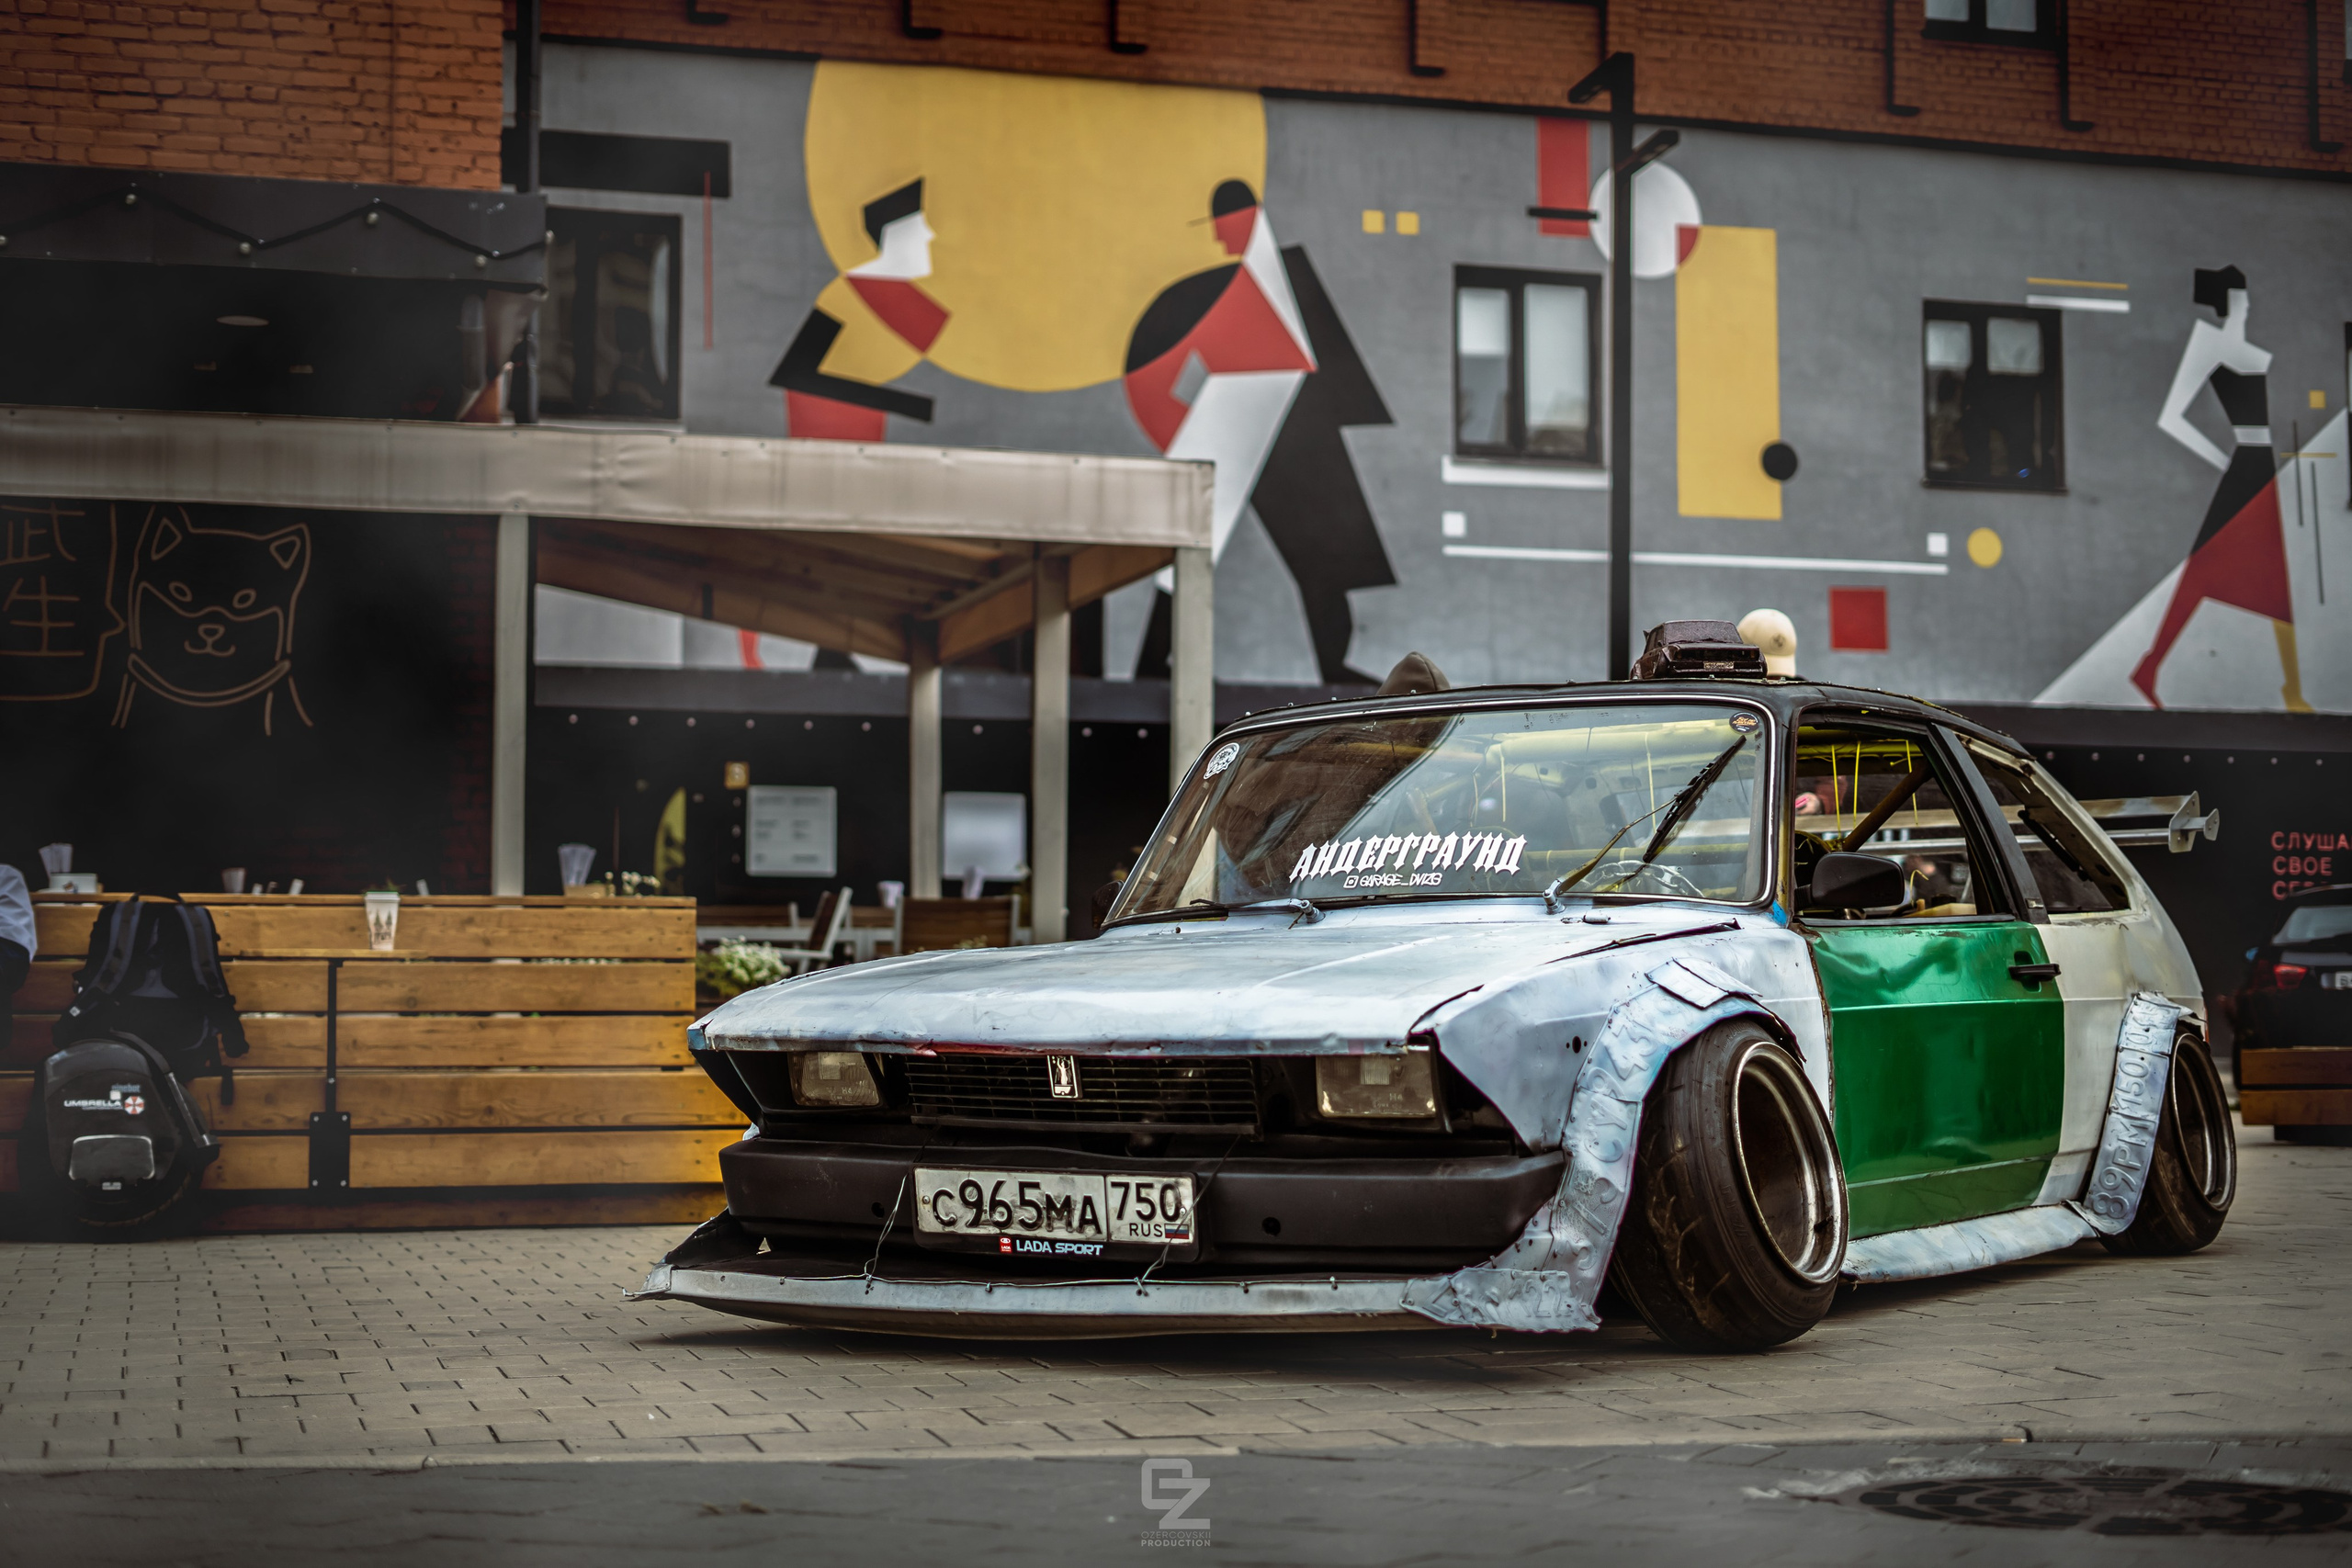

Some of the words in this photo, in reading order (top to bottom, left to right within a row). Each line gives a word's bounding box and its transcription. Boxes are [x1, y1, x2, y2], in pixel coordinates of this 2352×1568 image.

[2271, 830, 2352, 852] СЛУША
[1288, 830, 1528, 884] АНДЕРГРАУНД
[2272, 855, 2333, 876] СВОЕ
[63, 1100, 121, 1108] UMBRELLA
[1111, 1180, 1183, 1223] 750
[1128, 1223, 1163, 1238] RUS
[1016, 1239, 1052, 1253] LADA
[1055, 1242, 1103, 1256] SPORT
